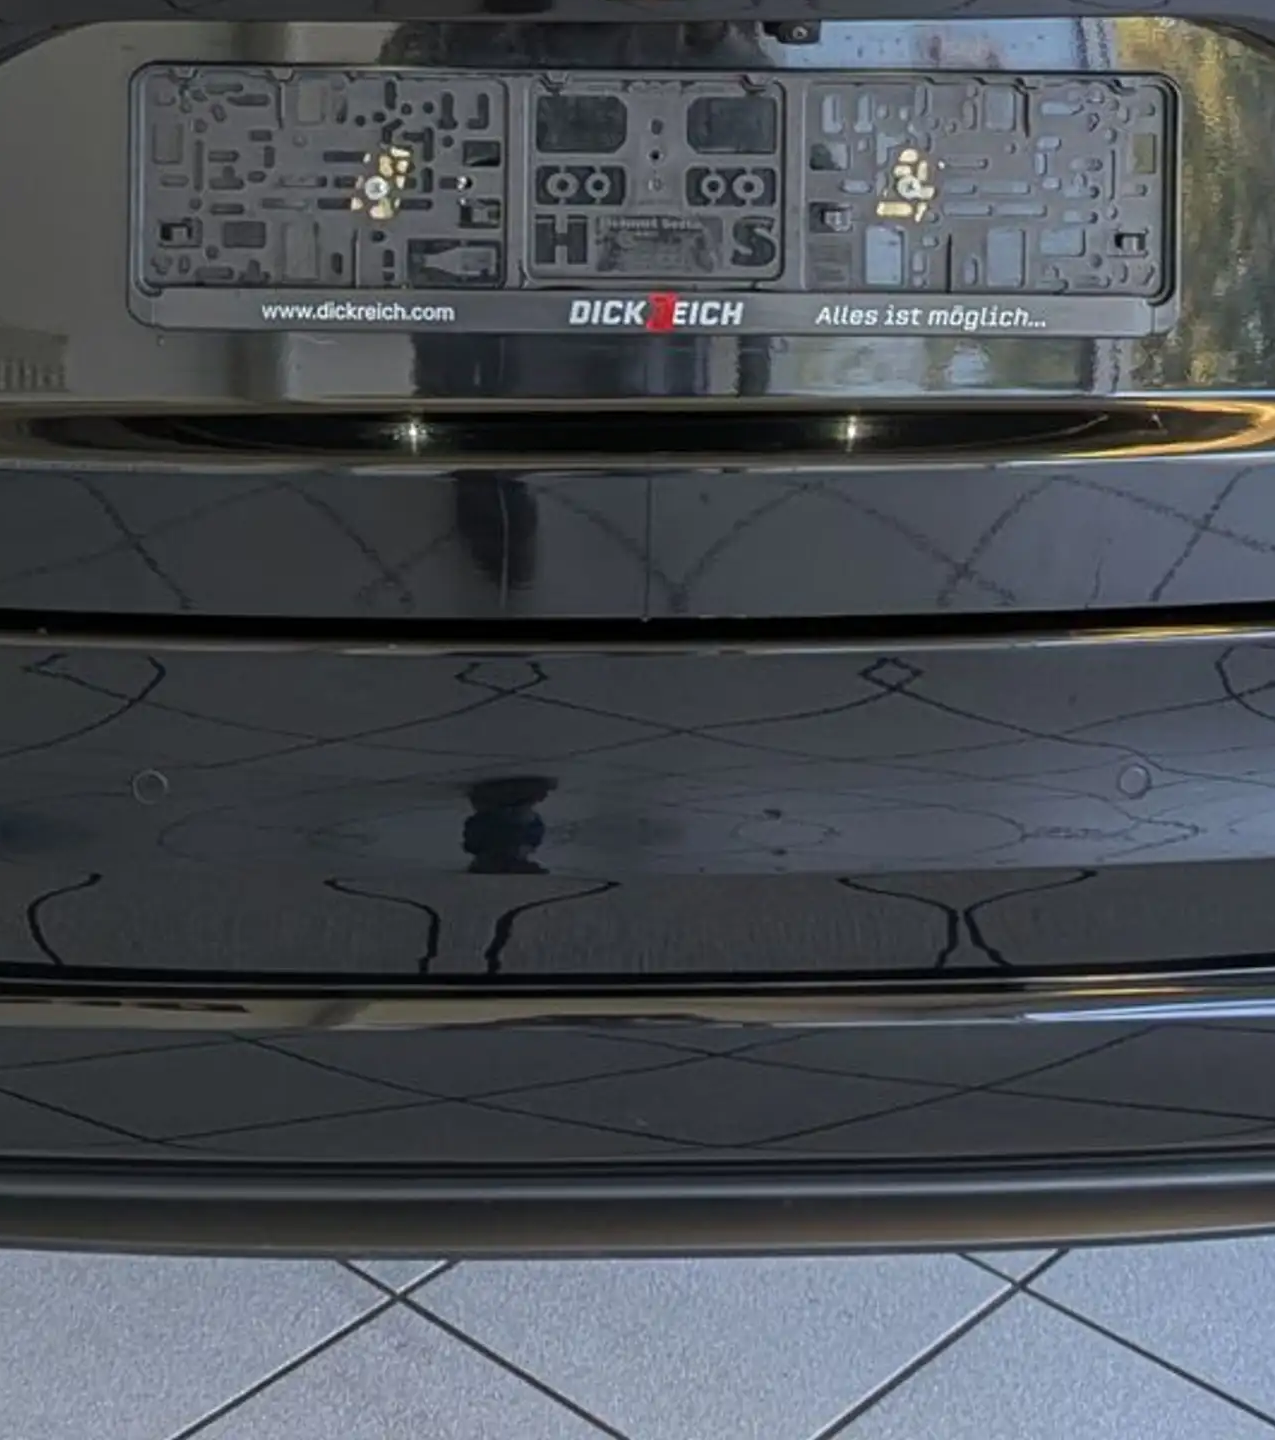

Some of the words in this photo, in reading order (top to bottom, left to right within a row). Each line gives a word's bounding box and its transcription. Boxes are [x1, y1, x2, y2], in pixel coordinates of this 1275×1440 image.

[261, 302, 455, 322] www.dickreich.com
[815, 305, 878, 326] Alles
[884, 304, 923, 326] ist
[927, 306, 1046, 331] möglich...
